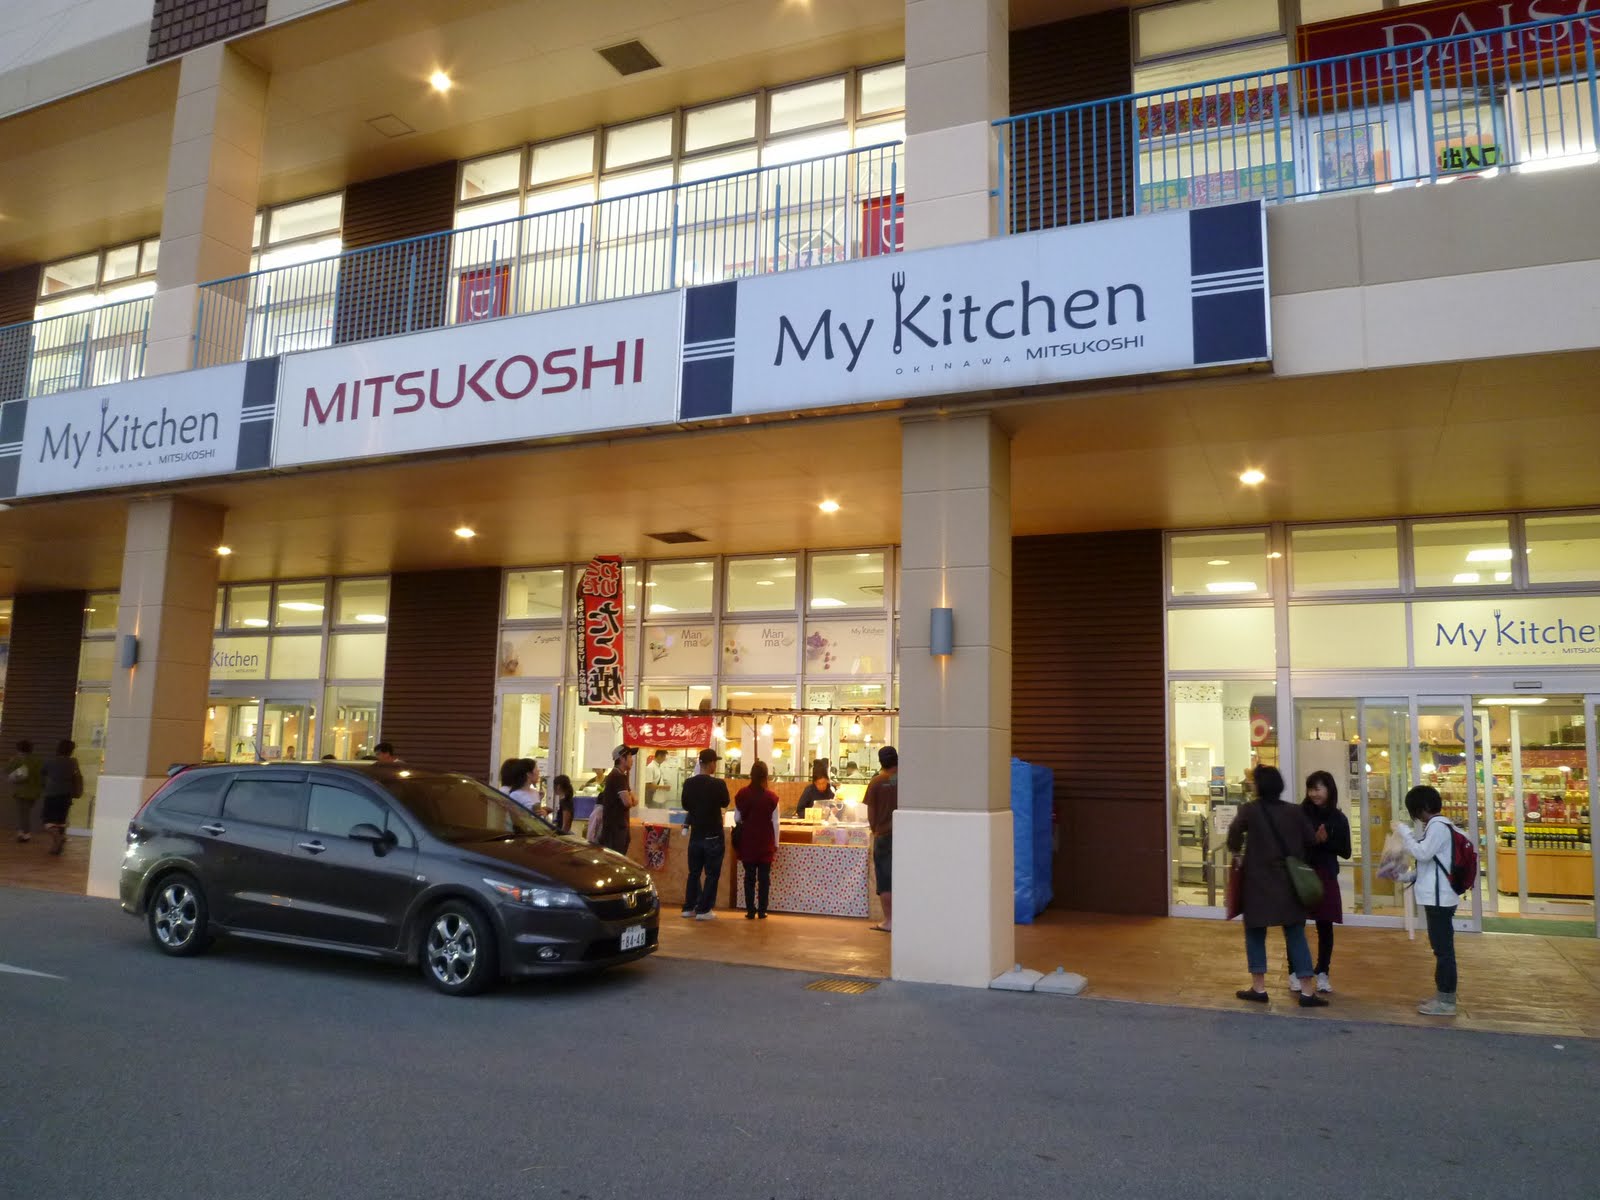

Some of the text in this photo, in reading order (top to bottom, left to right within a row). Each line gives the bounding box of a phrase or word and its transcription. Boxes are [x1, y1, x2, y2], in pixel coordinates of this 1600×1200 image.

[773, 271, 1146, 373] My Kitchen
[895, 334, 1144, 375] OKINAWA MITSUKOSHI
[303, 338, 645, 427] MITSUKOSHI
[39, 397, 218, 469] My Kitchen
[158, 447, 216, 465] MITSUKOSHI
[681, 629, 702, 639] Man
[683, 639, 699, 647] ma
[761, 628, 783, 639] Man
[764, 638, 780, 647] ma
[1435, 609, 1600, 653] My Kitche
